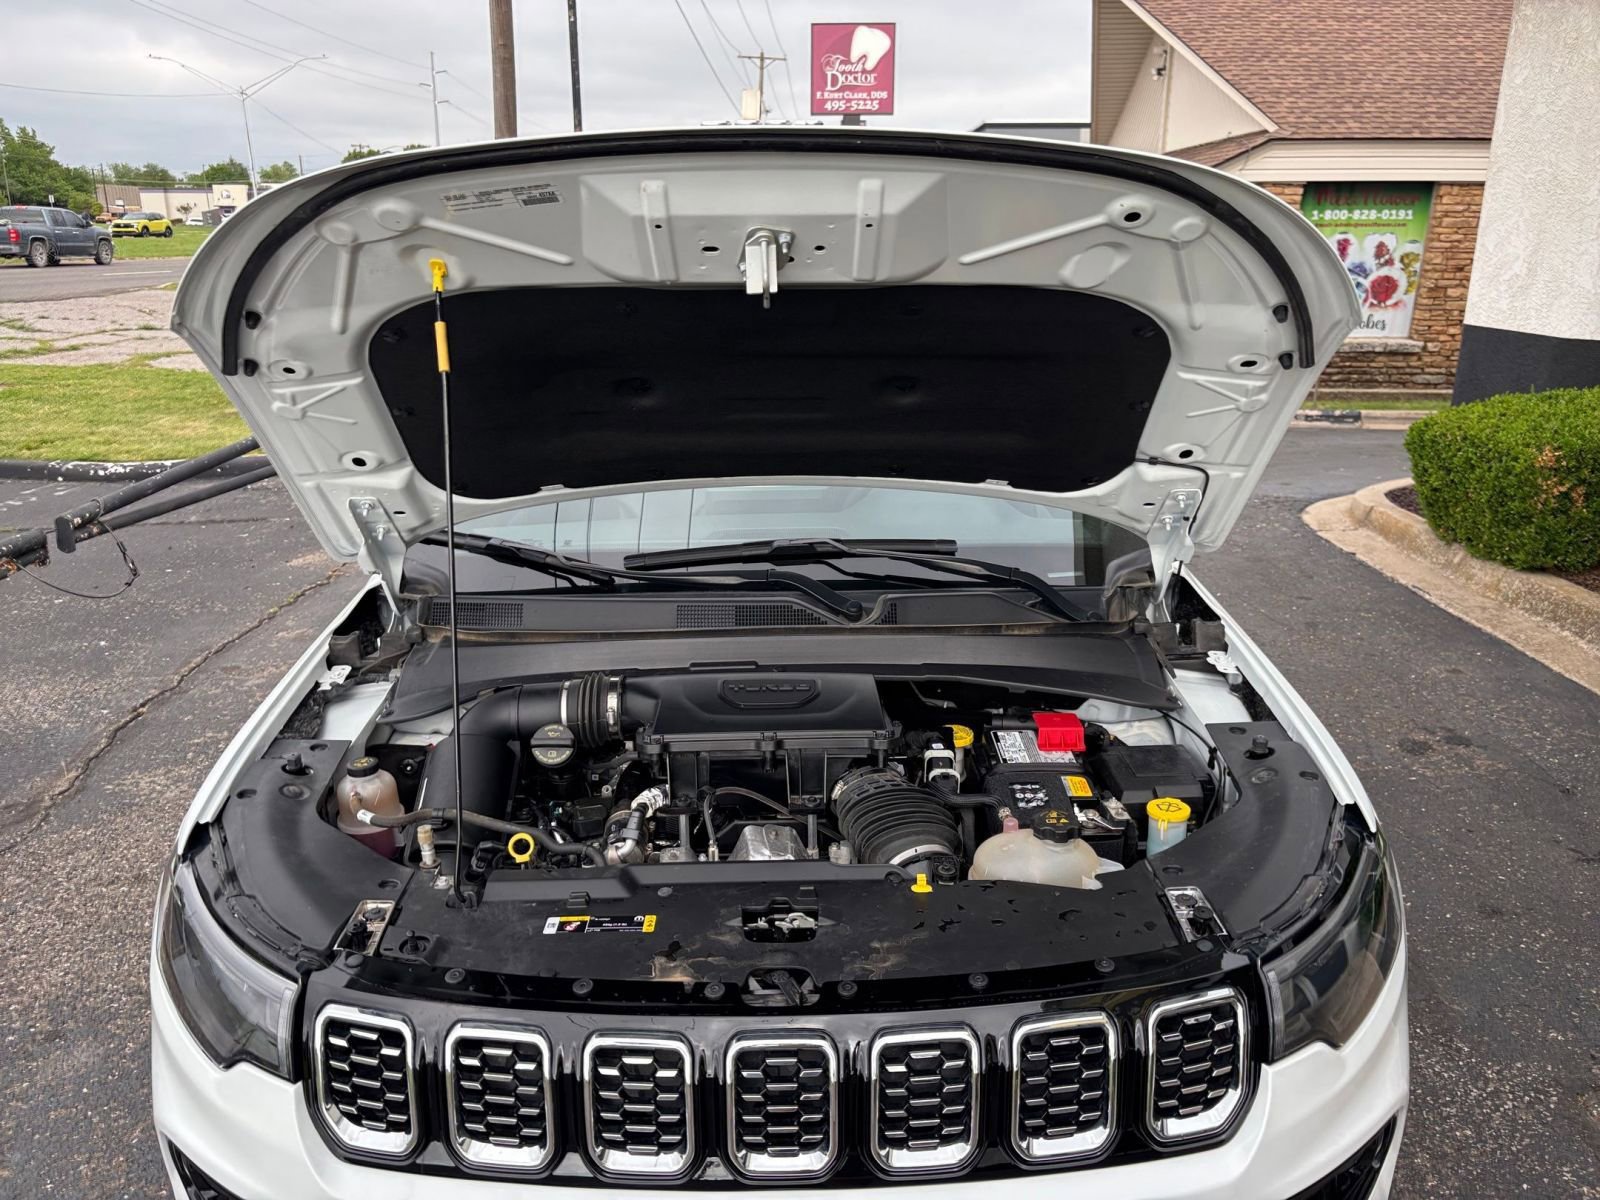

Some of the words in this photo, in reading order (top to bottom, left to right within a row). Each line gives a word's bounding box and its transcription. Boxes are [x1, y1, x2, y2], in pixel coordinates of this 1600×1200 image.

[821, 53, 866, 72] Tooth
[870, 91, 888, 99] DDS
[824, 100, 880, 111] 495-5225
[1358, 313, 1386, 331] obes
